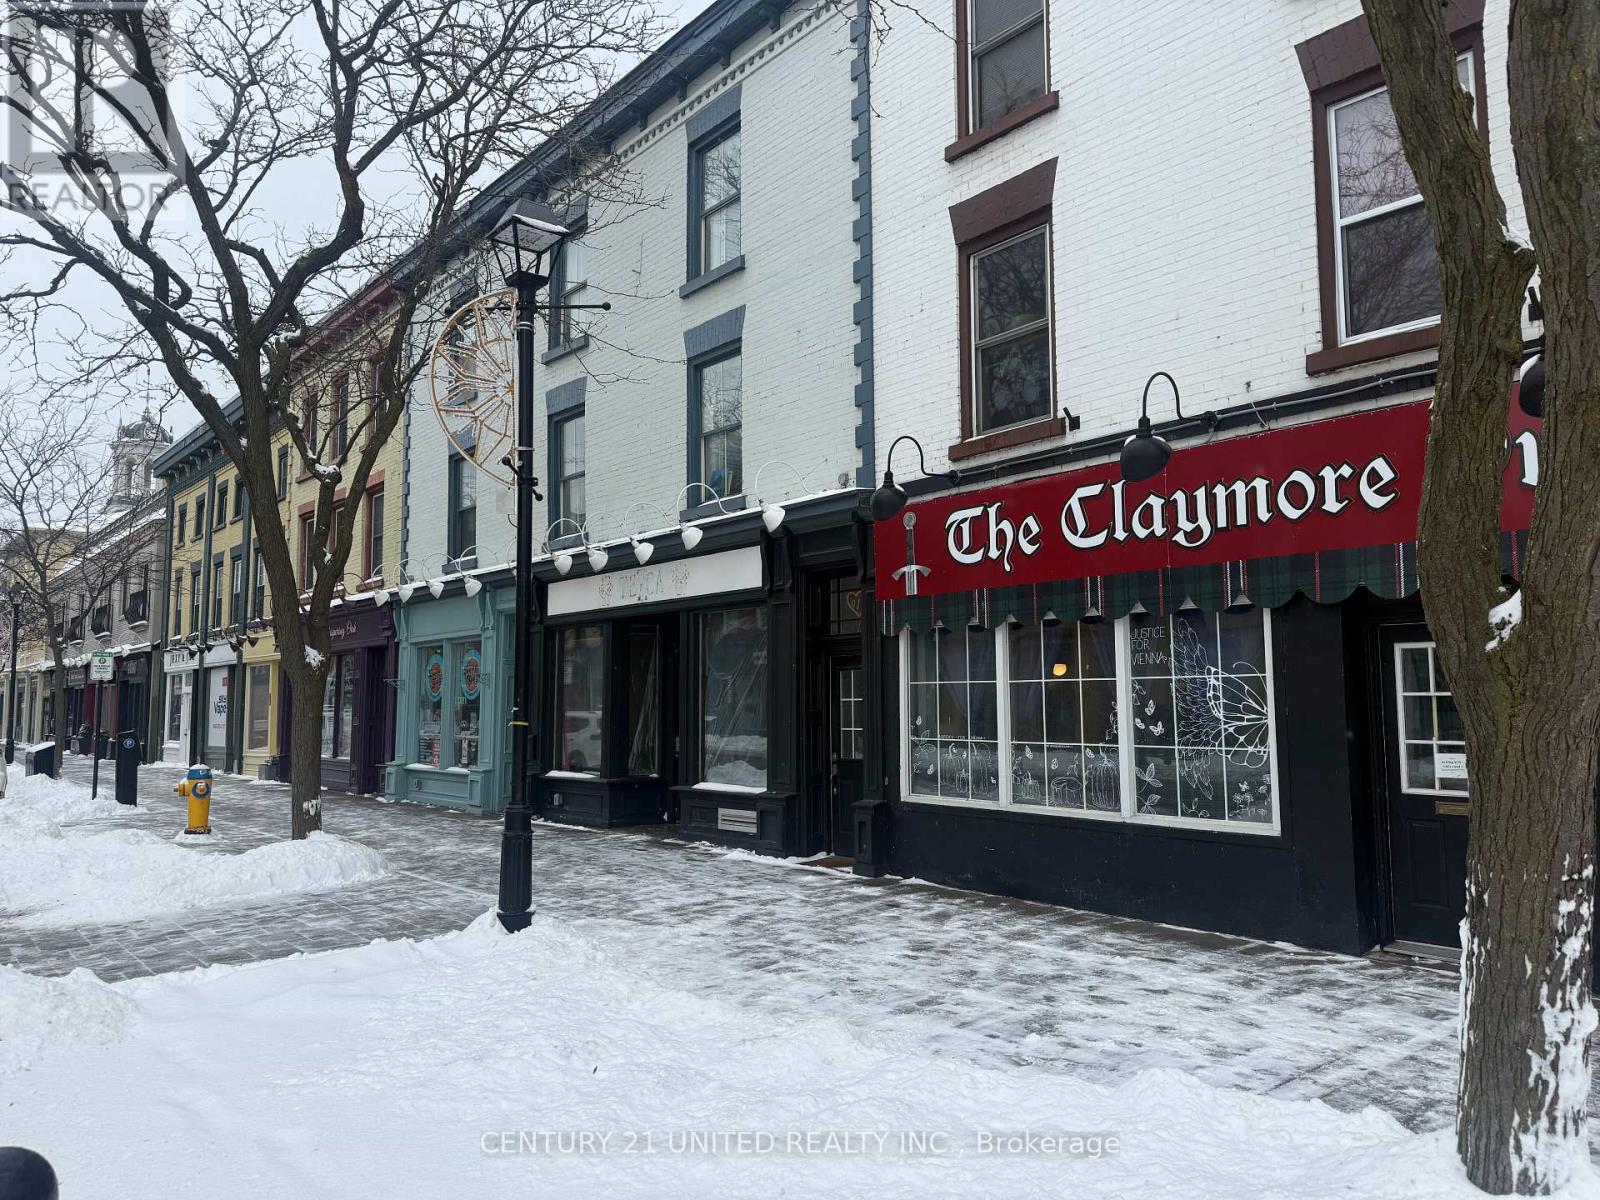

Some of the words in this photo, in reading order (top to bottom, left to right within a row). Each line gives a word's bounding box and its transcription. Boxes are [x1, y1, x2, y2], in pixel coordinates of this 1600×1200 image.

[945, 503, 1040, 572] The
[1060, 455, 1397, 549] Claymore
[1130, 626, 1166, 640] JUSTICE
[1131, 639, 1151, 651] FOR
